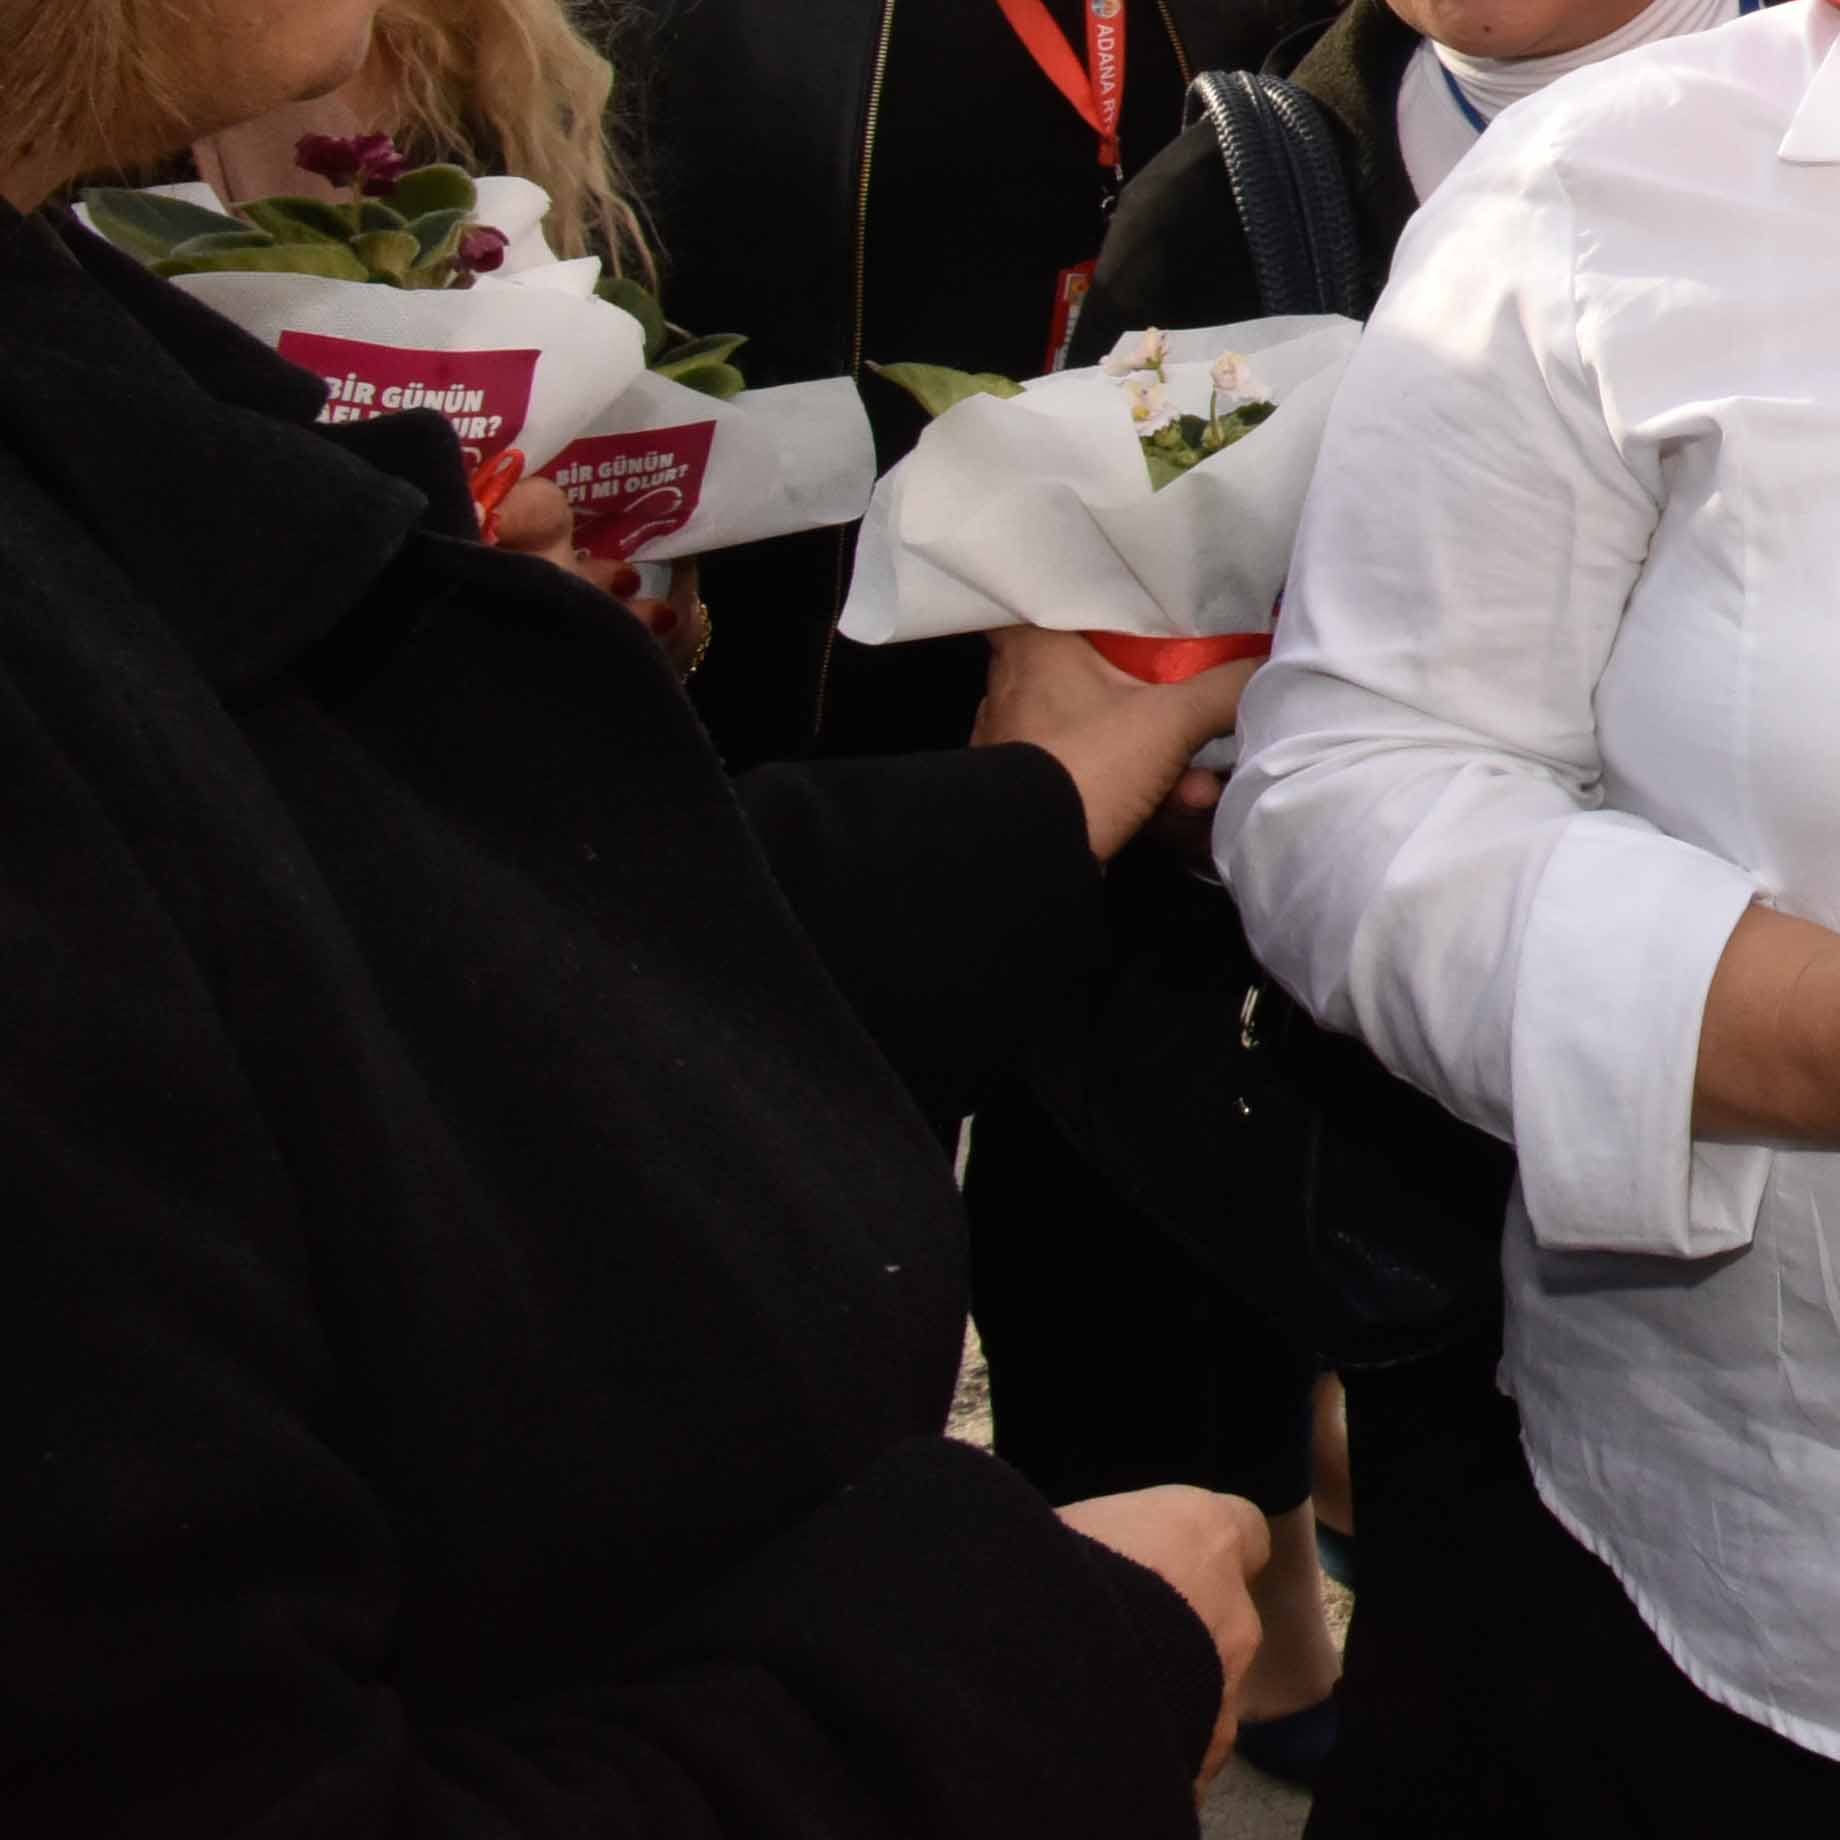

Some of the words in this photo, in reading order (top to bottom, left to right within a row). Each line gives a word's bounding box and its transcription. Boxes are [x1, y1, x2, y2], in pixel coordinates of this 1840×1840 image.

[1097, 23, 1115, 95] ADANA
[382, 382, 484, 414] GÜNÜN
[556, 462, 594, 487] BİR
[598, 451, 674, 479] GÜNÜN
[624, 464, 688, 493] OLUR?
